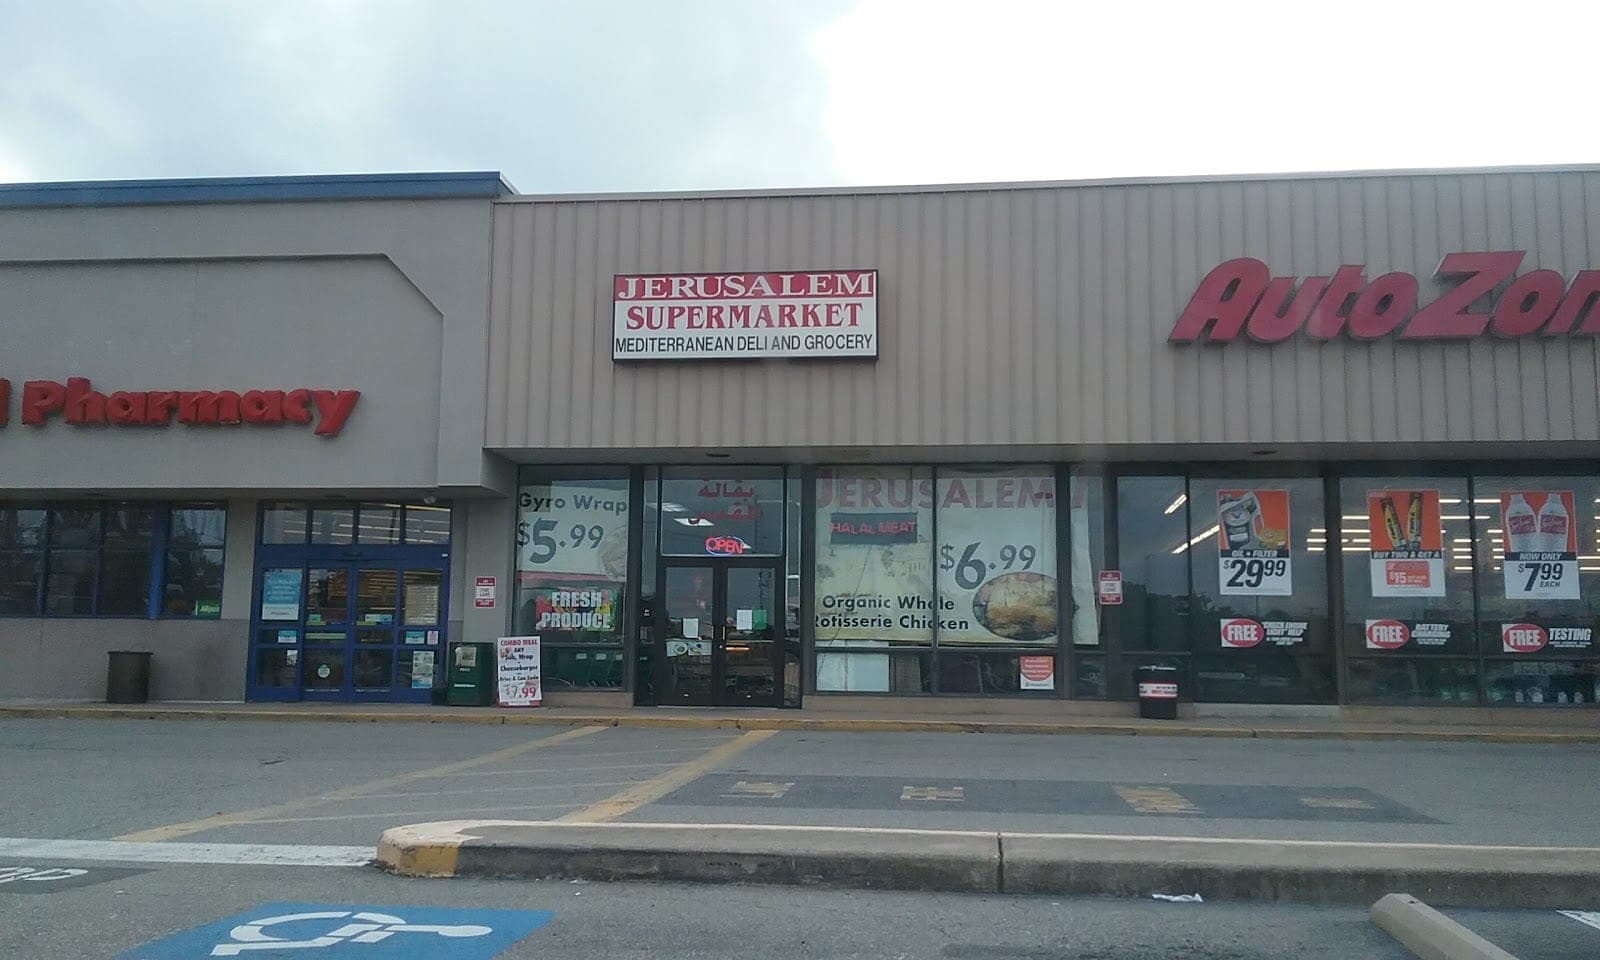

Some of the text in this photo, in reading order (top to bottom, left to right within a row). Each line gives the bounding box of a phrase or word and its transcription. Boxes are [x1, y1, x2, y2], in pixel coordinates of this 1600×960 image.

[618, 273, 872, 299] JERUSALEM
[626, 303, 862, 330] SUPERMARKET
[615, 334, 872, 353] MEDITERRANEAN DELI AND GROCERY
[21, 377, 361, 437] Pharmacy
[519, 492, 627, 516] Gyro Wrap
[878, 520, 916, 533] MEAT
[517, 518, 604, 564] $5.99
[705, 537, 743, 554] OPEN
[939, 541, 1036, 590] $6.99
[552, 591, 602, 607] FRESH
[822, 594, 891, 611] Organic
[541, 612, 611, 628] PRODUCE
[1228, 625, 1258, 641] FREE
[1372, 625, 1403, 642] FREE
[1509, 629, 1541, 646] FREE
[1549, 627, 1592, 641] TESTING
